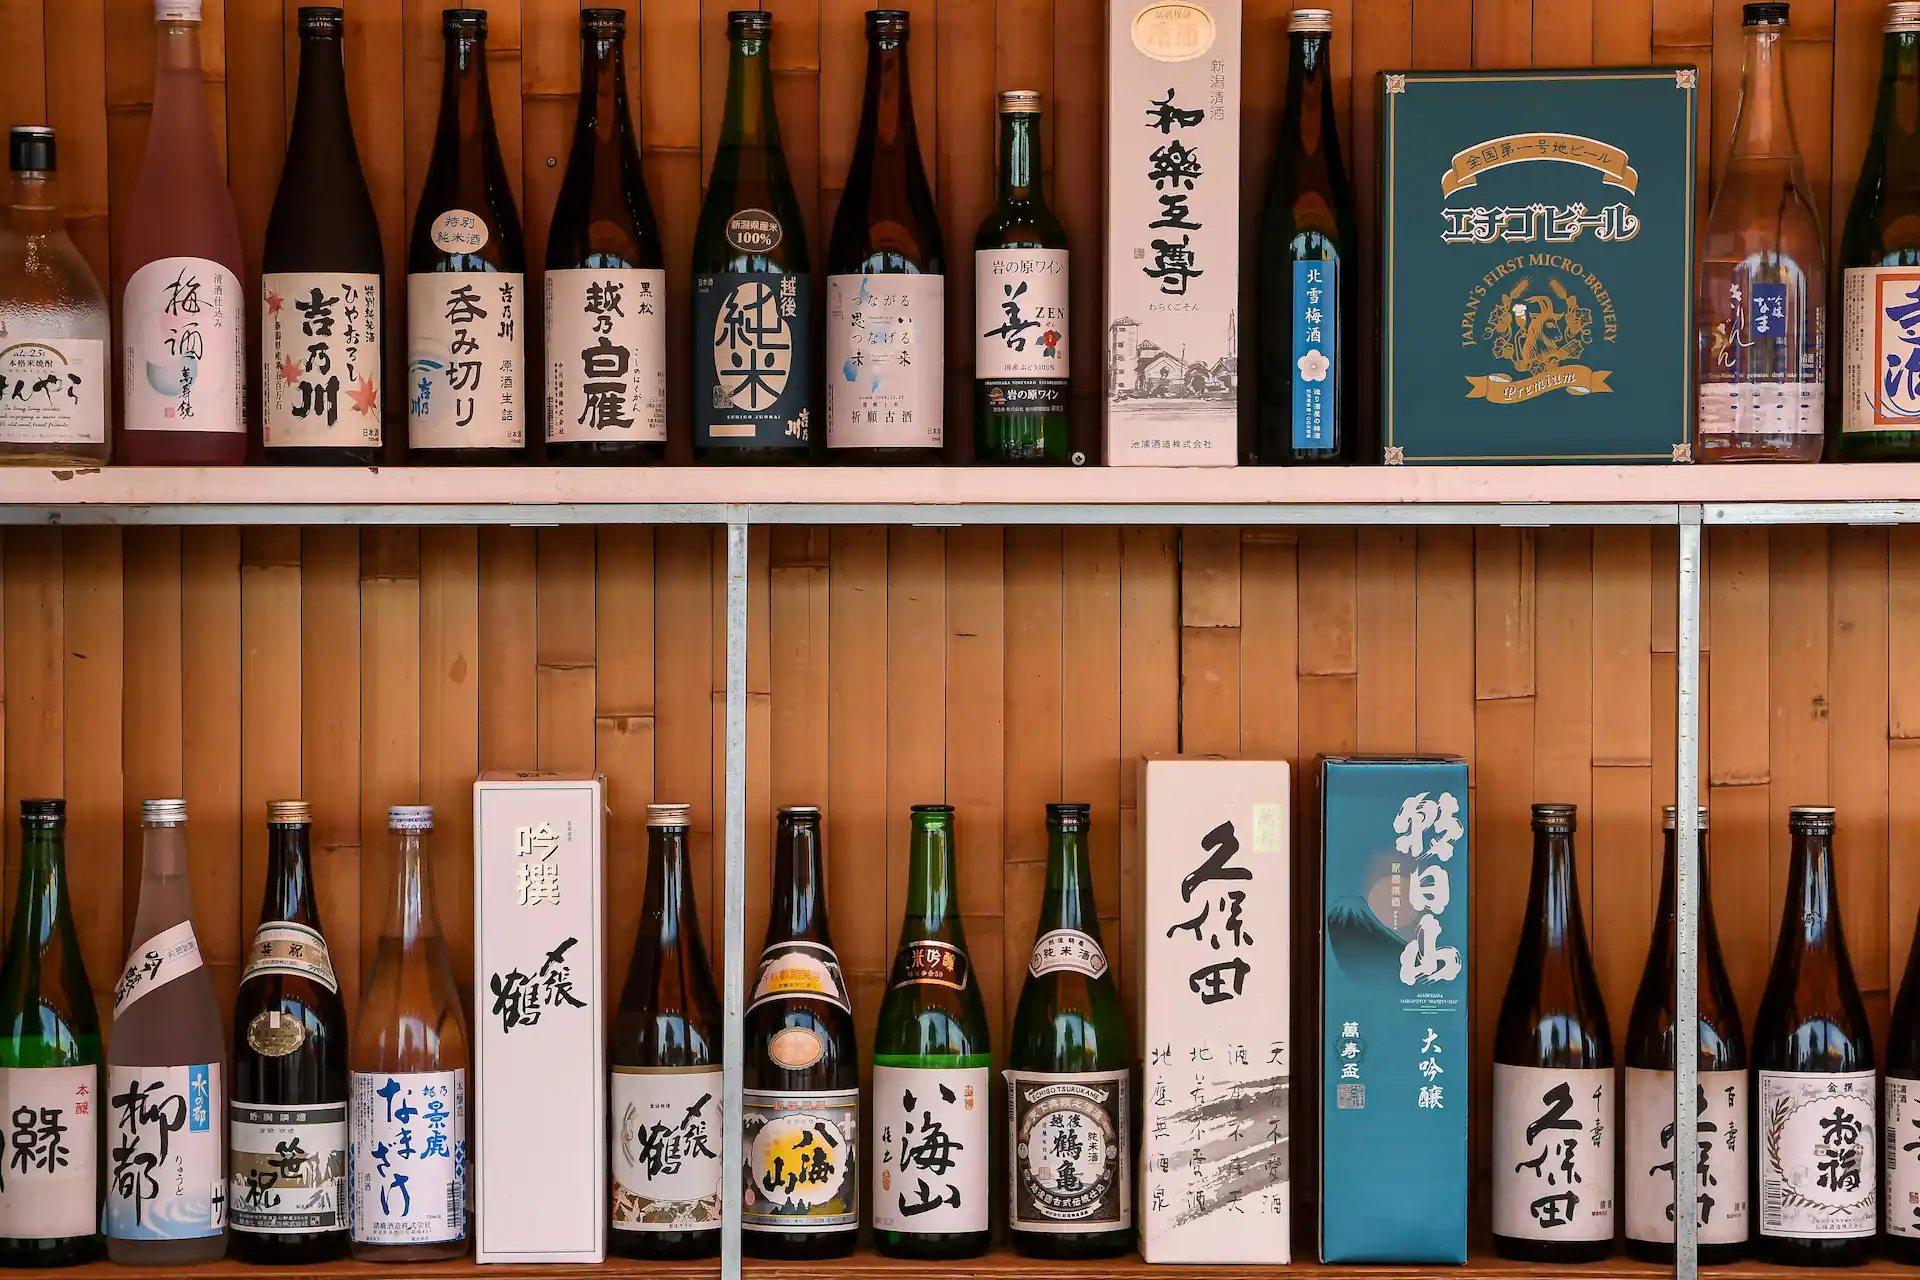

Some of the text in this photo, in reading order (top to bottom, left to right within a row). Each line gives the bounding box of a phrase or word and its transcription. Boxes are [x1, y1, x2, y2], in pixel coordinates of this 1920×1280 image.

[1209, 59, 1225, 121] 新潟清酒
[1464, 138, 1613, 171] 全国第一号地ビール
[730, 218, 779, 232] 新潟県産米
[736, 231, 772, 246] 100%
[1439, 202, 1642, 249] エチゴビール
[780, 275, 797, 318] 越後
[991, 259, 1064, 275] 岩の原ワイン
[162, 265, 214, 362] 梅酒
[213, 273, 224, 329] 清酒仕込み
[497, 281, 514, 342] 吉乃川
[638, 282, 654, 315] 黒松
[851, 294, 911, 307] つながる
[1035, 306, 1065, 319] ZEN
[1148, 302, 1200, 314] わらくごそん
[1305, 268, 1324, 344] 北雪梅酒
[1461, 252, 1619, 347] JAPAN'S FIRST MICRO-BREWERY
[291, 287, 341, 428] 吉乃川
[341, 283, 360, 382] ひやおろし
[444, 284, 487, 427] 呑み切り
[578, 280, 635, 431] 越乃白雁
[714, 282, 790, 409] 純米
[851, 331, 910, 344] つなげる
[9, 359, 54, 368] 本格米焼酎
[499, 359, 513, 421] 原酒生詰
[1503, 373, 1577, 401] Premium
[851, 410, 912, 424] 祈願古酒
[1006, 389, 1059, 401] 岩の原ワイン
[514, 820, 561, 907] 吟撰
[1166, 819, 1254, 1006] 久保田
[1043, 945, 1092, 961] 純米酒
[191, 1070, 208, 1130] 水の都
[1031, 1086, 1101, 1102] ECHIGO TSURUKAME
[110, 1080, 187, 1228] 柳都
[762, 1121, 840, 1196] 八海山
[898, 1082, 964, 1218] 八海山
[1514, 1081, 1584, 1230] 久保田
[1816, 1105, 1863, 1194] お福
